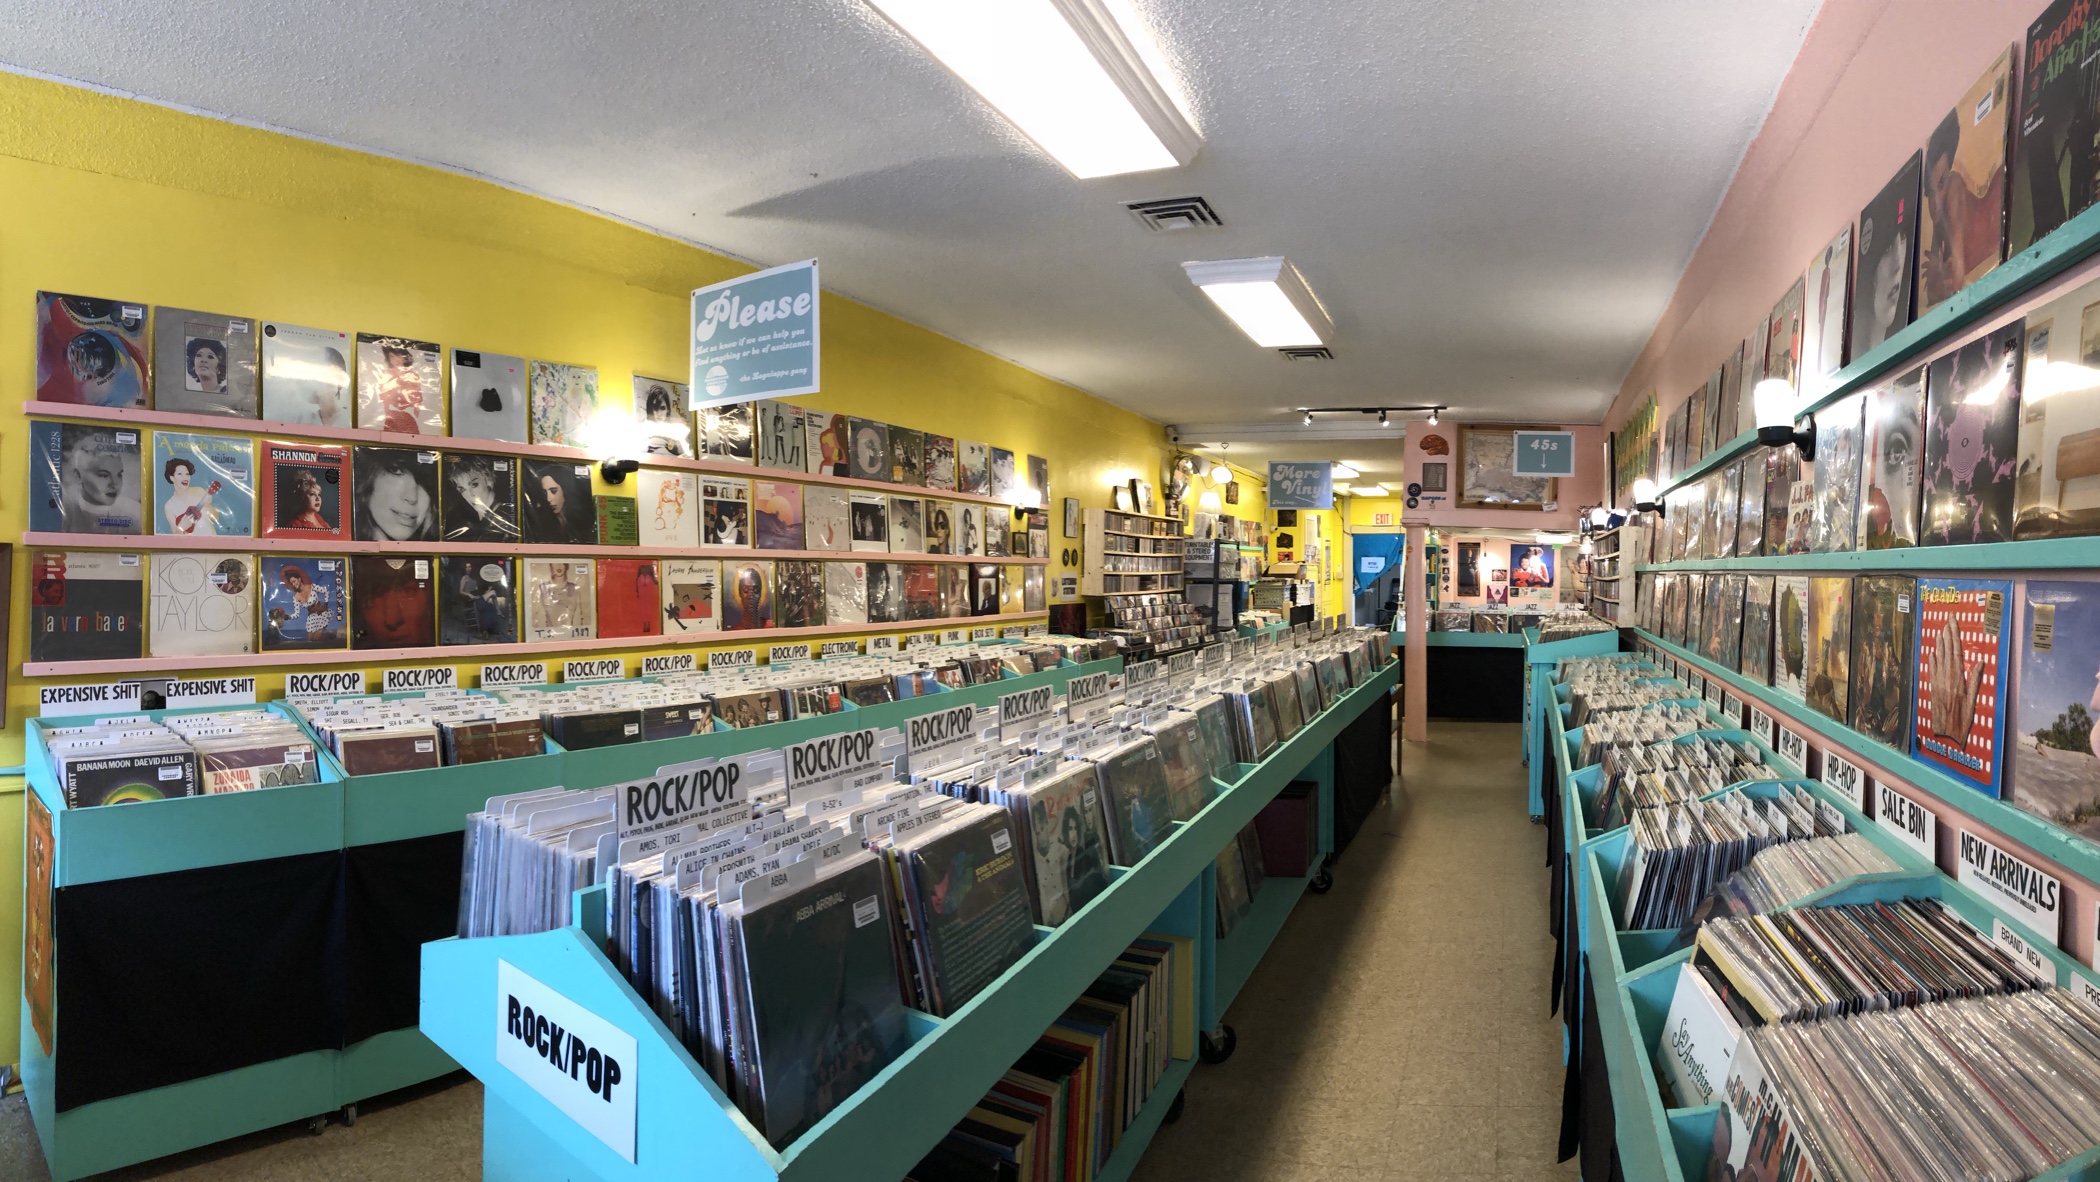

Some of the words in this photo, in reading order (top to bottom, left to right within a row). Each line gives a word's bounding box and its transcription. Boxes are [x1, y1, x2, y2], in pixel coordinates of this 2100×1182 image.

[696, 289, 811, 342] Please
[719, 341, 737, 350] know
[739, 337, 746, 346] if
[758, 334, 771, 342] can
[773, 330, 789, 339] help
[791, 329, 805, 339] you
[710, 352, 741, 363] anything
[751, 347, 760, 355] be
[762, 344, 770, 354] of
[1530, 439, 1558, 451] 45s
[272, 450, 317, 463] SHANNON
[1273, 464, 1320, 481] More
[1281, 479, 1328, 499] Vinyl
[1375, 513, 1389, 525] EXIT
[151, 595, 249, 633] TAYLOR
[874, 637, 892, 649] METAL
[948, 631, 960, 641] PUNK
[772, 646, 808, 660] ROCK/POP
[822, 641, 858, 655] ELECTRONIC
[646, 655, 692, 671] ROCK/POP
[712, 651, 753, 666] ROCK/POP
[389, 668, 452, 687] ROCK/POP
[485, 664, 543, 682] ROCK/POP
[568, 660, 620, 677] ROCK/POP
[166, 680, 229, 697] EXPENSIVE
[231, 678, 255, 693] SHIT
[291, 673, 360, 692] ROCK/POP
[1071, 673, 1107, 700] ROCK/POP
[41, 686, 109, 704] EXPENSIVE
[113, 684, 140, 700] SHIT
[1004, 687, 1050, 721] ROCK/POP
[912, 706, 973, 748] ROCK/POP
[1754, 710, 1769, 738] HIP-HOP
[1782, 727, 1802, 761] HIP-HOP
[77, 761, 108, 772] BANANA
[108, 759, 131, 769] MOON
[134, 757, 160, 767] DAEVID
[161, 755, 184, 764] ALLEN
[792, 730, 874, 780] ROCK/POP
[185, 762, 193, 781] GARY
[1828, 753, 1857, 794] HIP-HOP
[69, 772, 77, 799] WYATT
[627, 763, 740, 826] ROCK/POP
[712, 810, 748, 828] COLLECTIVE
[877, 813, 895, 827] ARCADE
[897, 808, 910, 818] FIRE
[1882, 787, 1905, 828] SALE
[1909, 803, 1926, 843] BIN
[745, 822, 764, 835] ALT-J
[896, 820, 915, 833] APPLES
[639, 839, 660, 852] AMOS,
[665, 833, 680, 846] TORI
[823, 844, 841, 859] AC/DC
[735, 867, 759, 884] ADAMS,
[762, 859, 780, 873] RYAN
[771, 873, 788, 887] ABBA
[1961, 831, 1987, 871] NEW
[1990, 849, 2056, 912] ARRIVALS
[2001, 927, 2022, 954] BRAND
[2026, 948, 2041, 969] NEW
[1672, 1018, 1690, 1048] Say
[507, 994, 621, 1104] ROCK/POP
[1678, 1043, 1713, 1105] Anything
